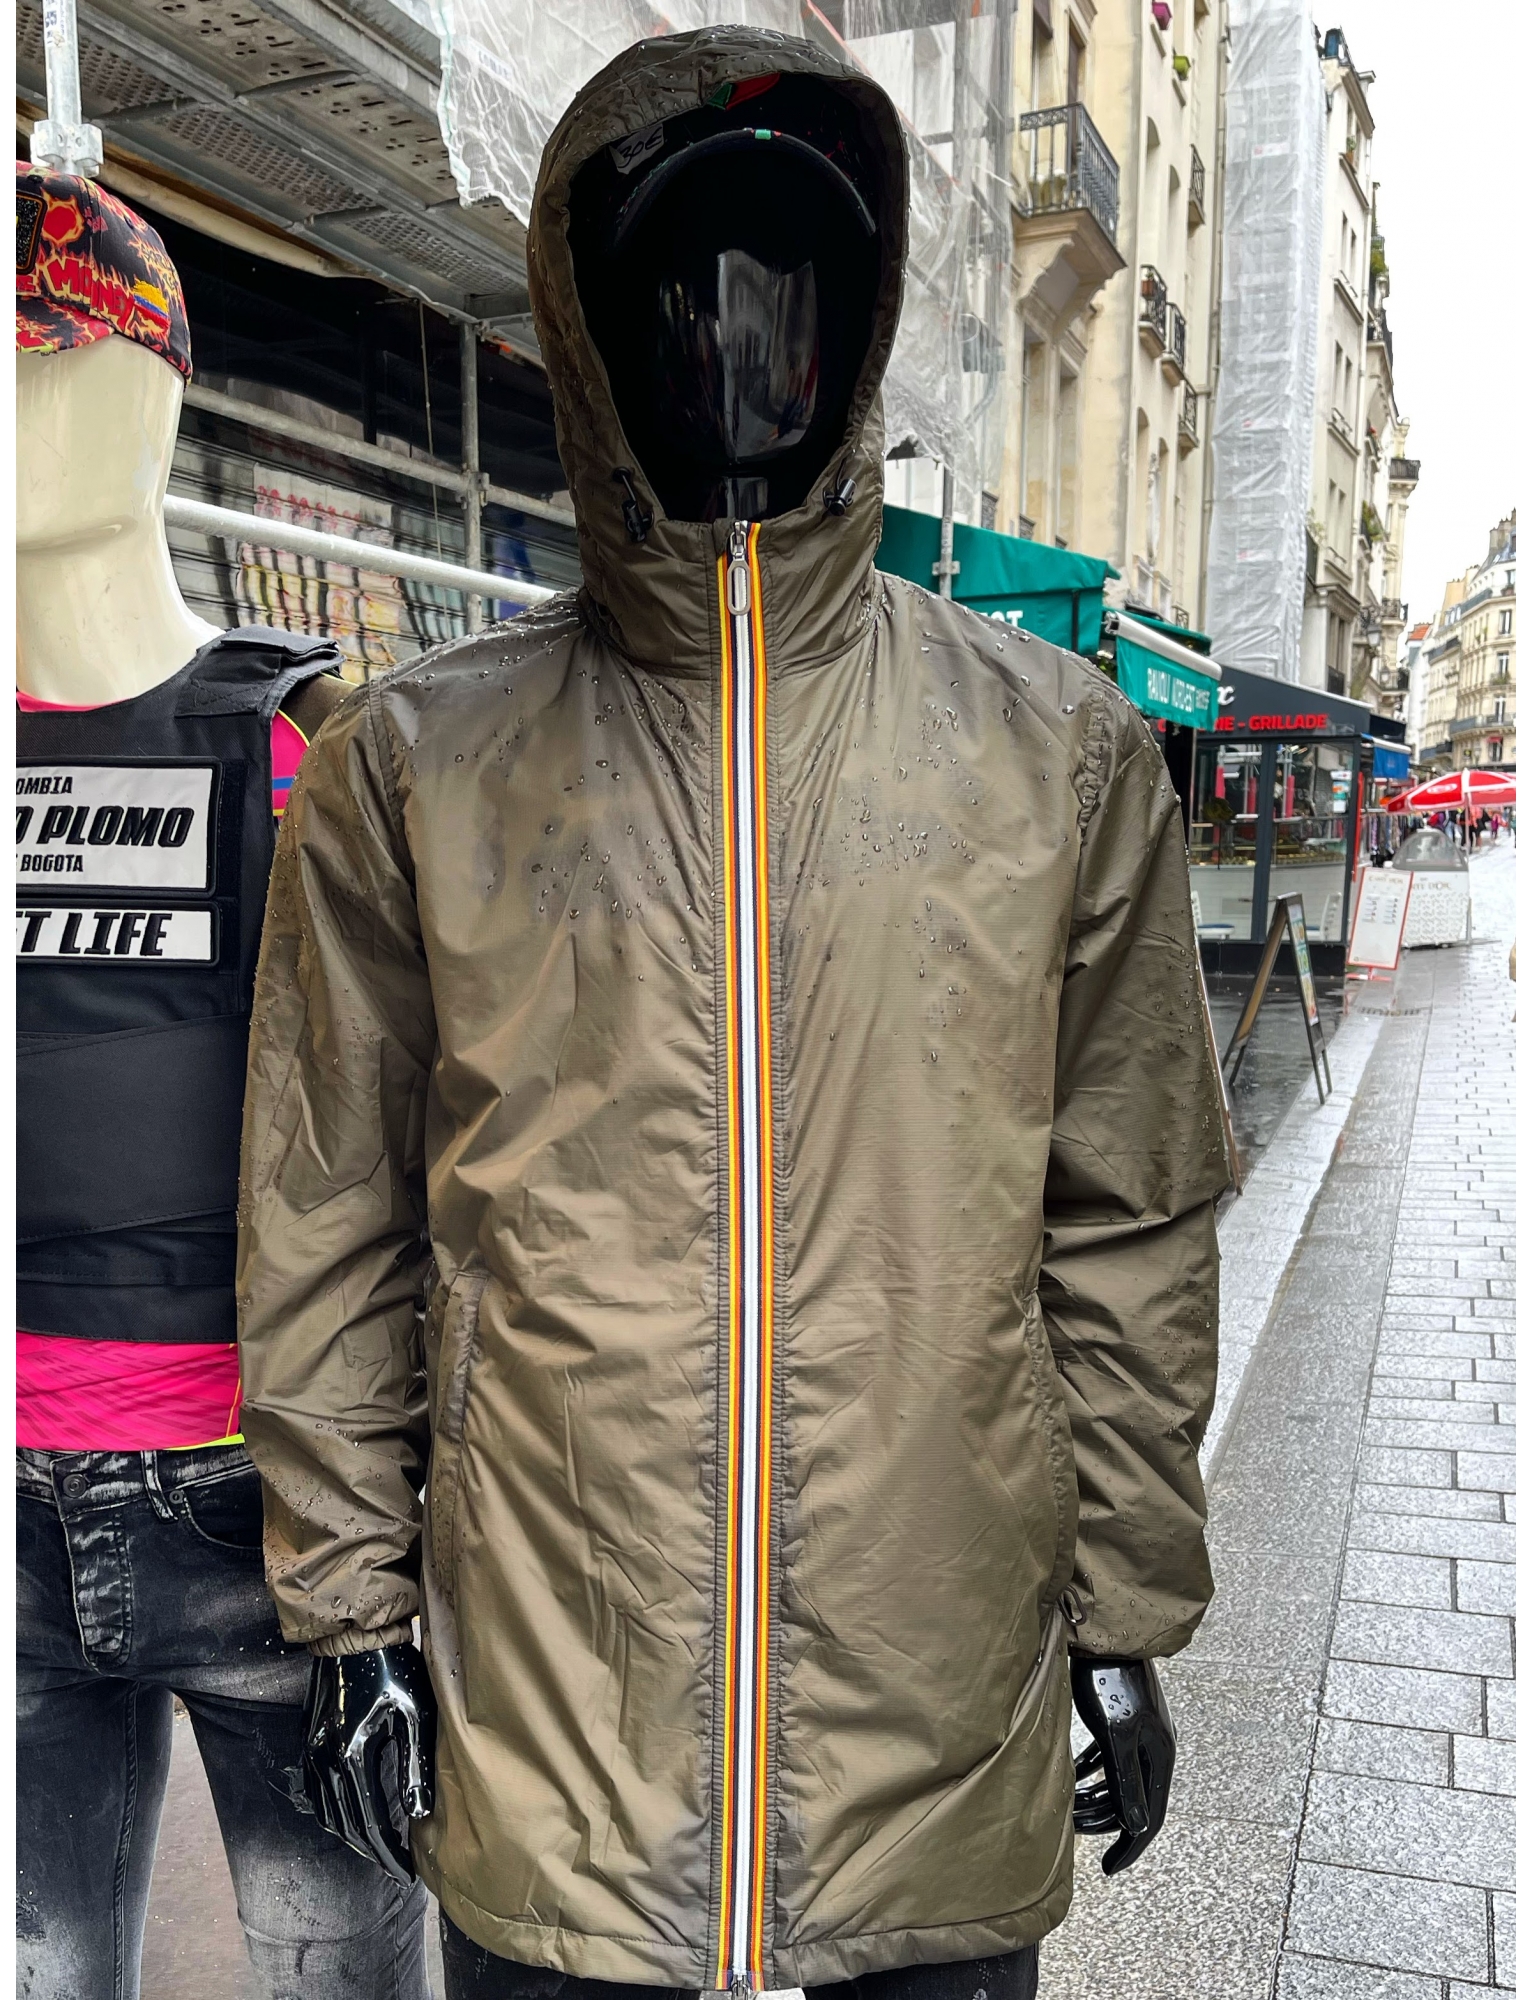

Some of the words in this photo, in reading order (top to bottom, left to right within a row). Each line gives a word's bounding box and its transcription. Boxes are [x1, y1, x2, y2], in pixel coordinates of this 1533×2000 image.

[47, 258, 135, 333] MONEY
[1248, 714, 1328, 731] GRILLADE
[36, 805, 195, 848] PLOMO
[20, 854, 84, 872] BOGOTA
[58, 912, 173, 956] LIFE
